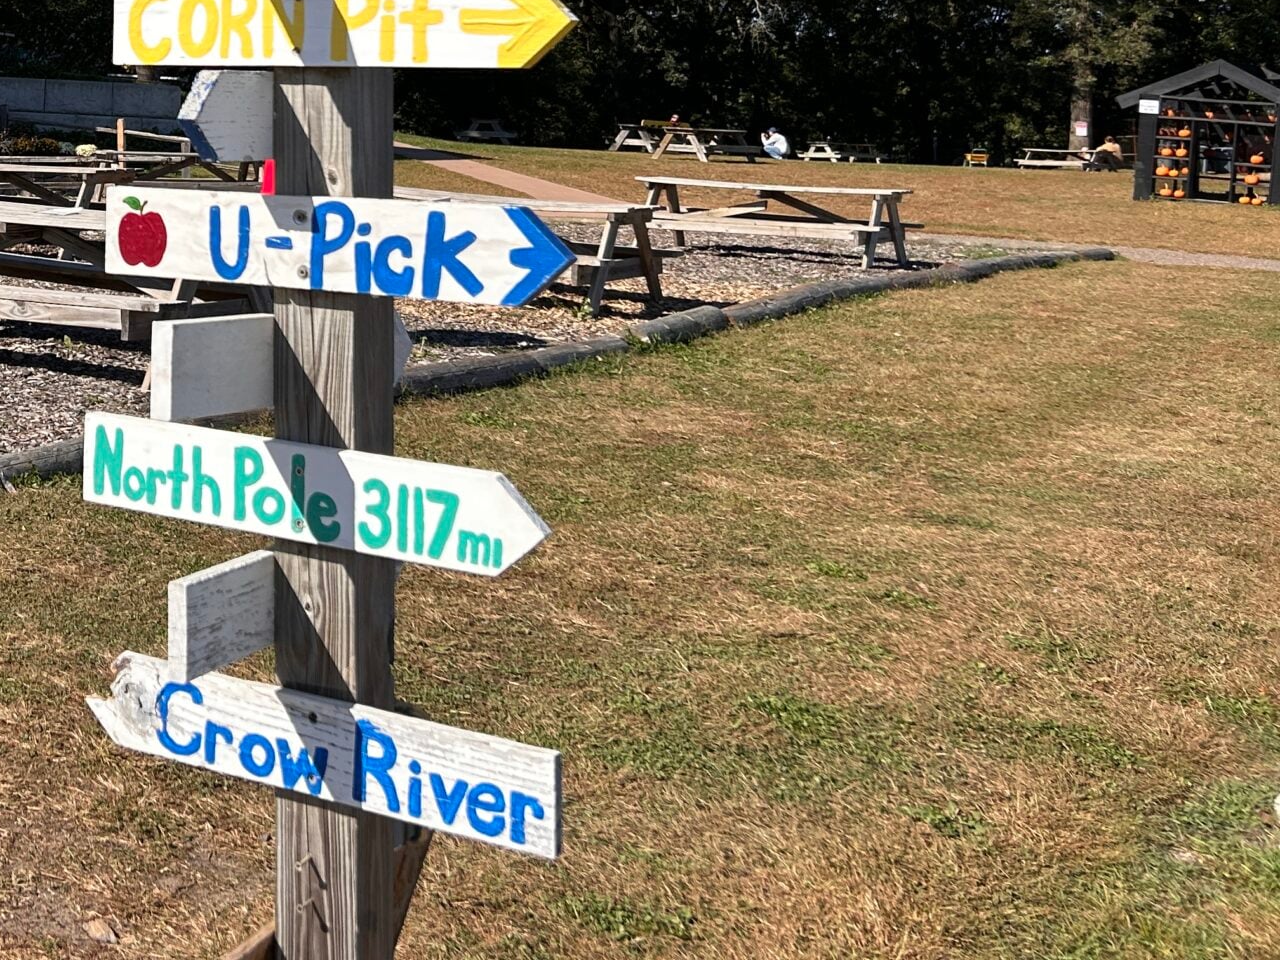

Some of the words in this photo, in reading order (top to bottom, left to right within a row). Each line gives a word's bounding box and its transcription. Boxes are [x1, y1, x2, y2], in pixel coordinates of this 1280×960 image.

[208, 200, 484, 301] U-Pick
[93, 424, 222, 516] North
[233, 445, 341, 543] Pole
[156, 681, 329, 797] Crow
[352, 718, 545, 846] River
